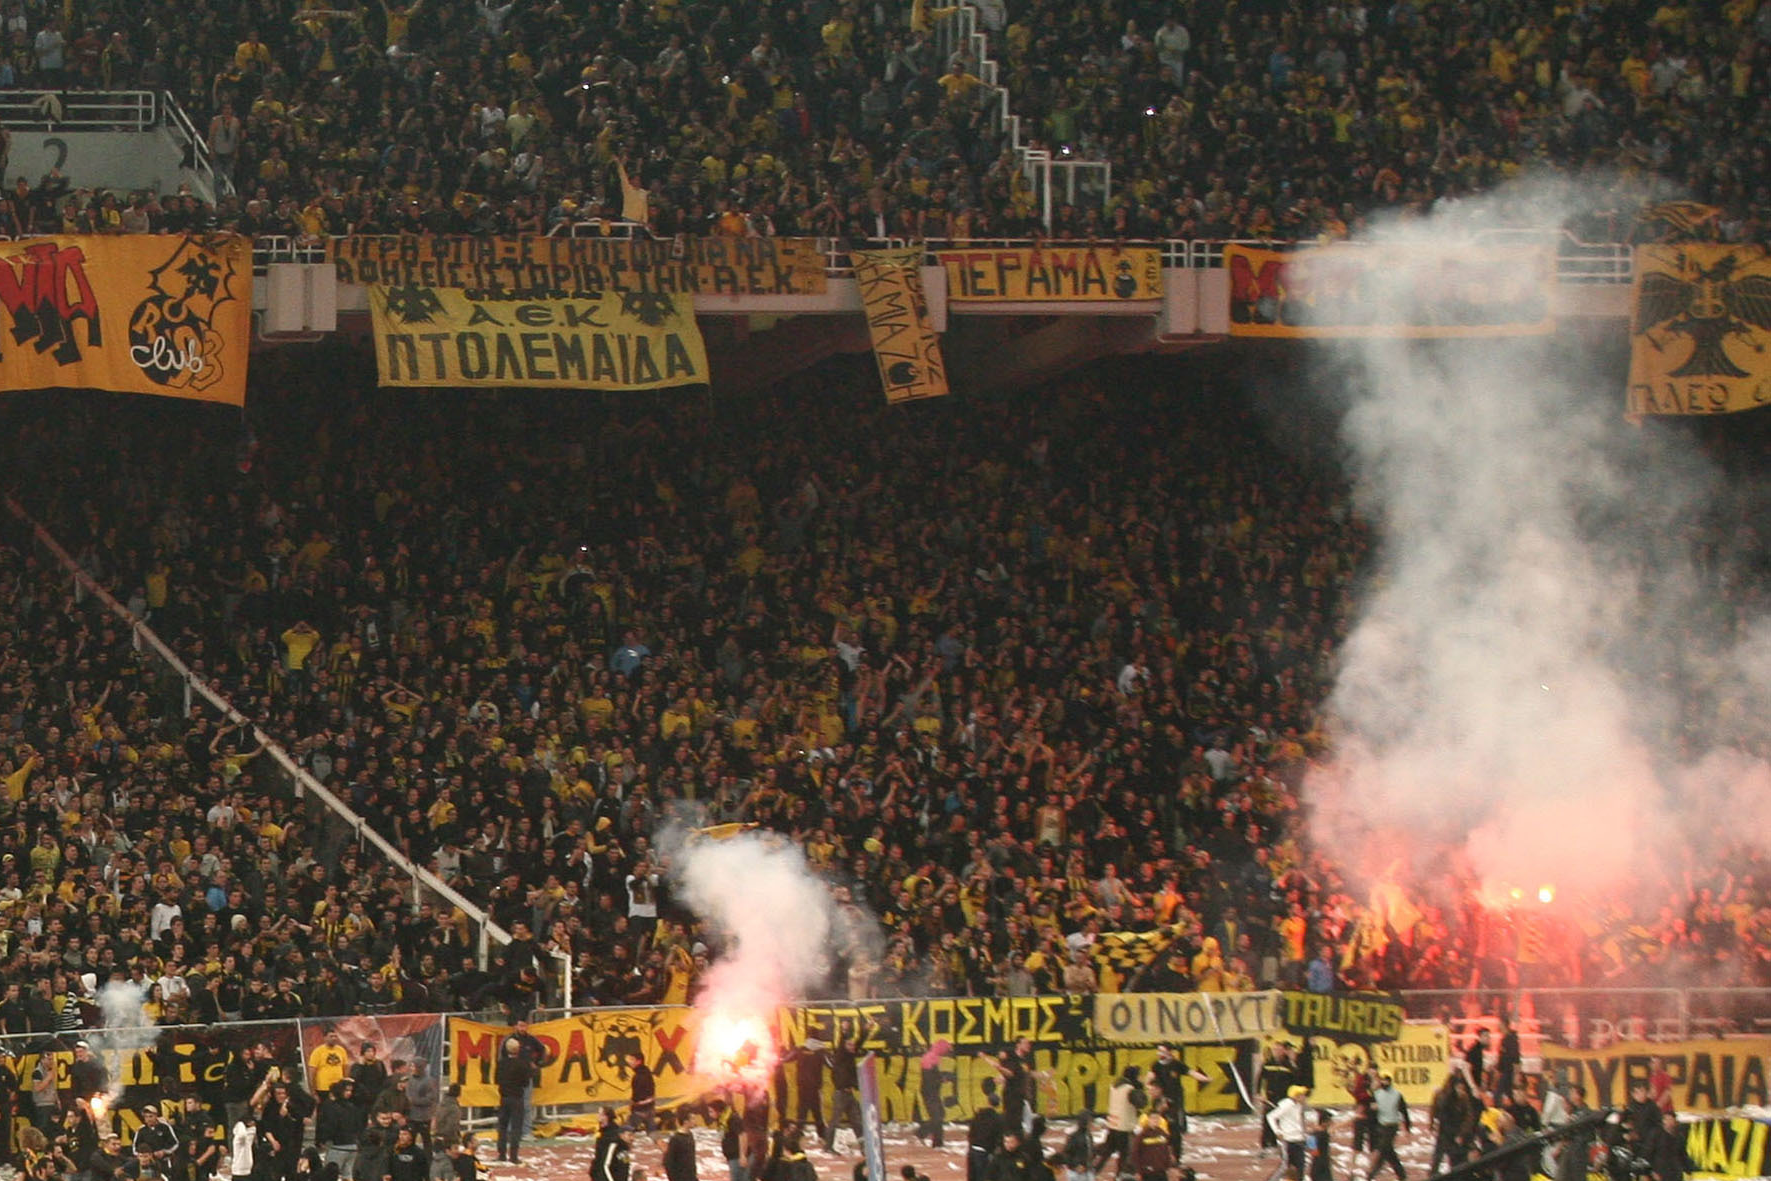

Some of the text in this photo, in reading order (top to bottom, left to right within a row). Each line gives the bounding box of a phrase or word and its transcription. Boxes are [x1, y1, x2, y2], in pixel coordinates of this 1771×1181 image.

[941, 252, 1108, 297] ΠΕΡΑΜΑ
[901, 996, 1065, 1047] ΚΟΣΜΟΣ
[1283, 991, 1404, 1036] TAUROS
[1393, 1067, 1430, 1084] CLUB
